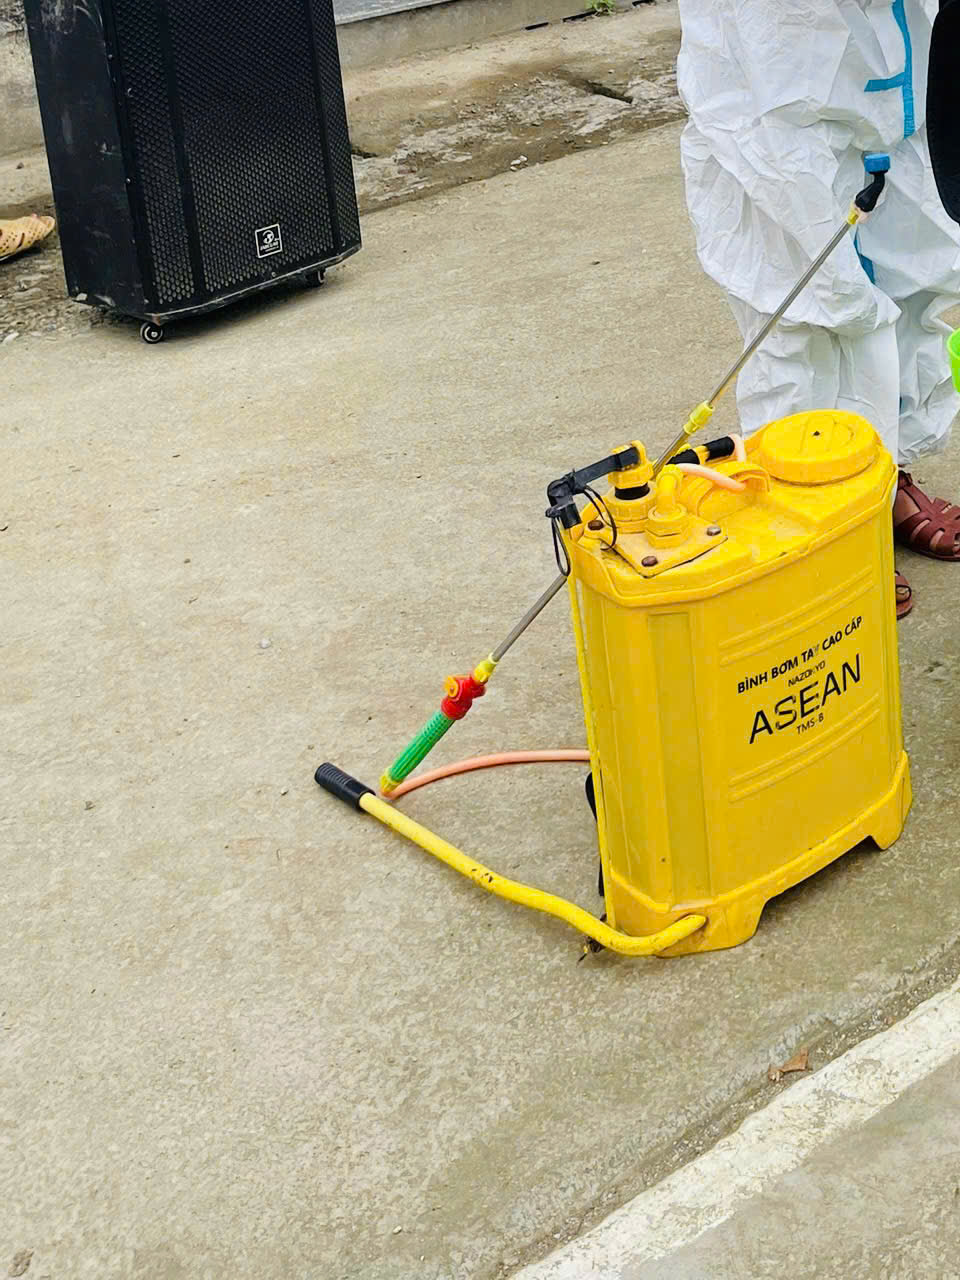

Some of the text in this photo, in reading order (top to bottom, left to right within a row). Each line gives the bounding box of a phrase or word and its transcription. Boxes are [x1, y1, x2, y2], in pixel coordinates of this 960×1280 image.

[737, 671, 768, 694] BÌNH
[771, 656, 799, 679] BƠM
[822, 630, 843, 651] CAO
[749, 653, 861, 745] ASEAN
